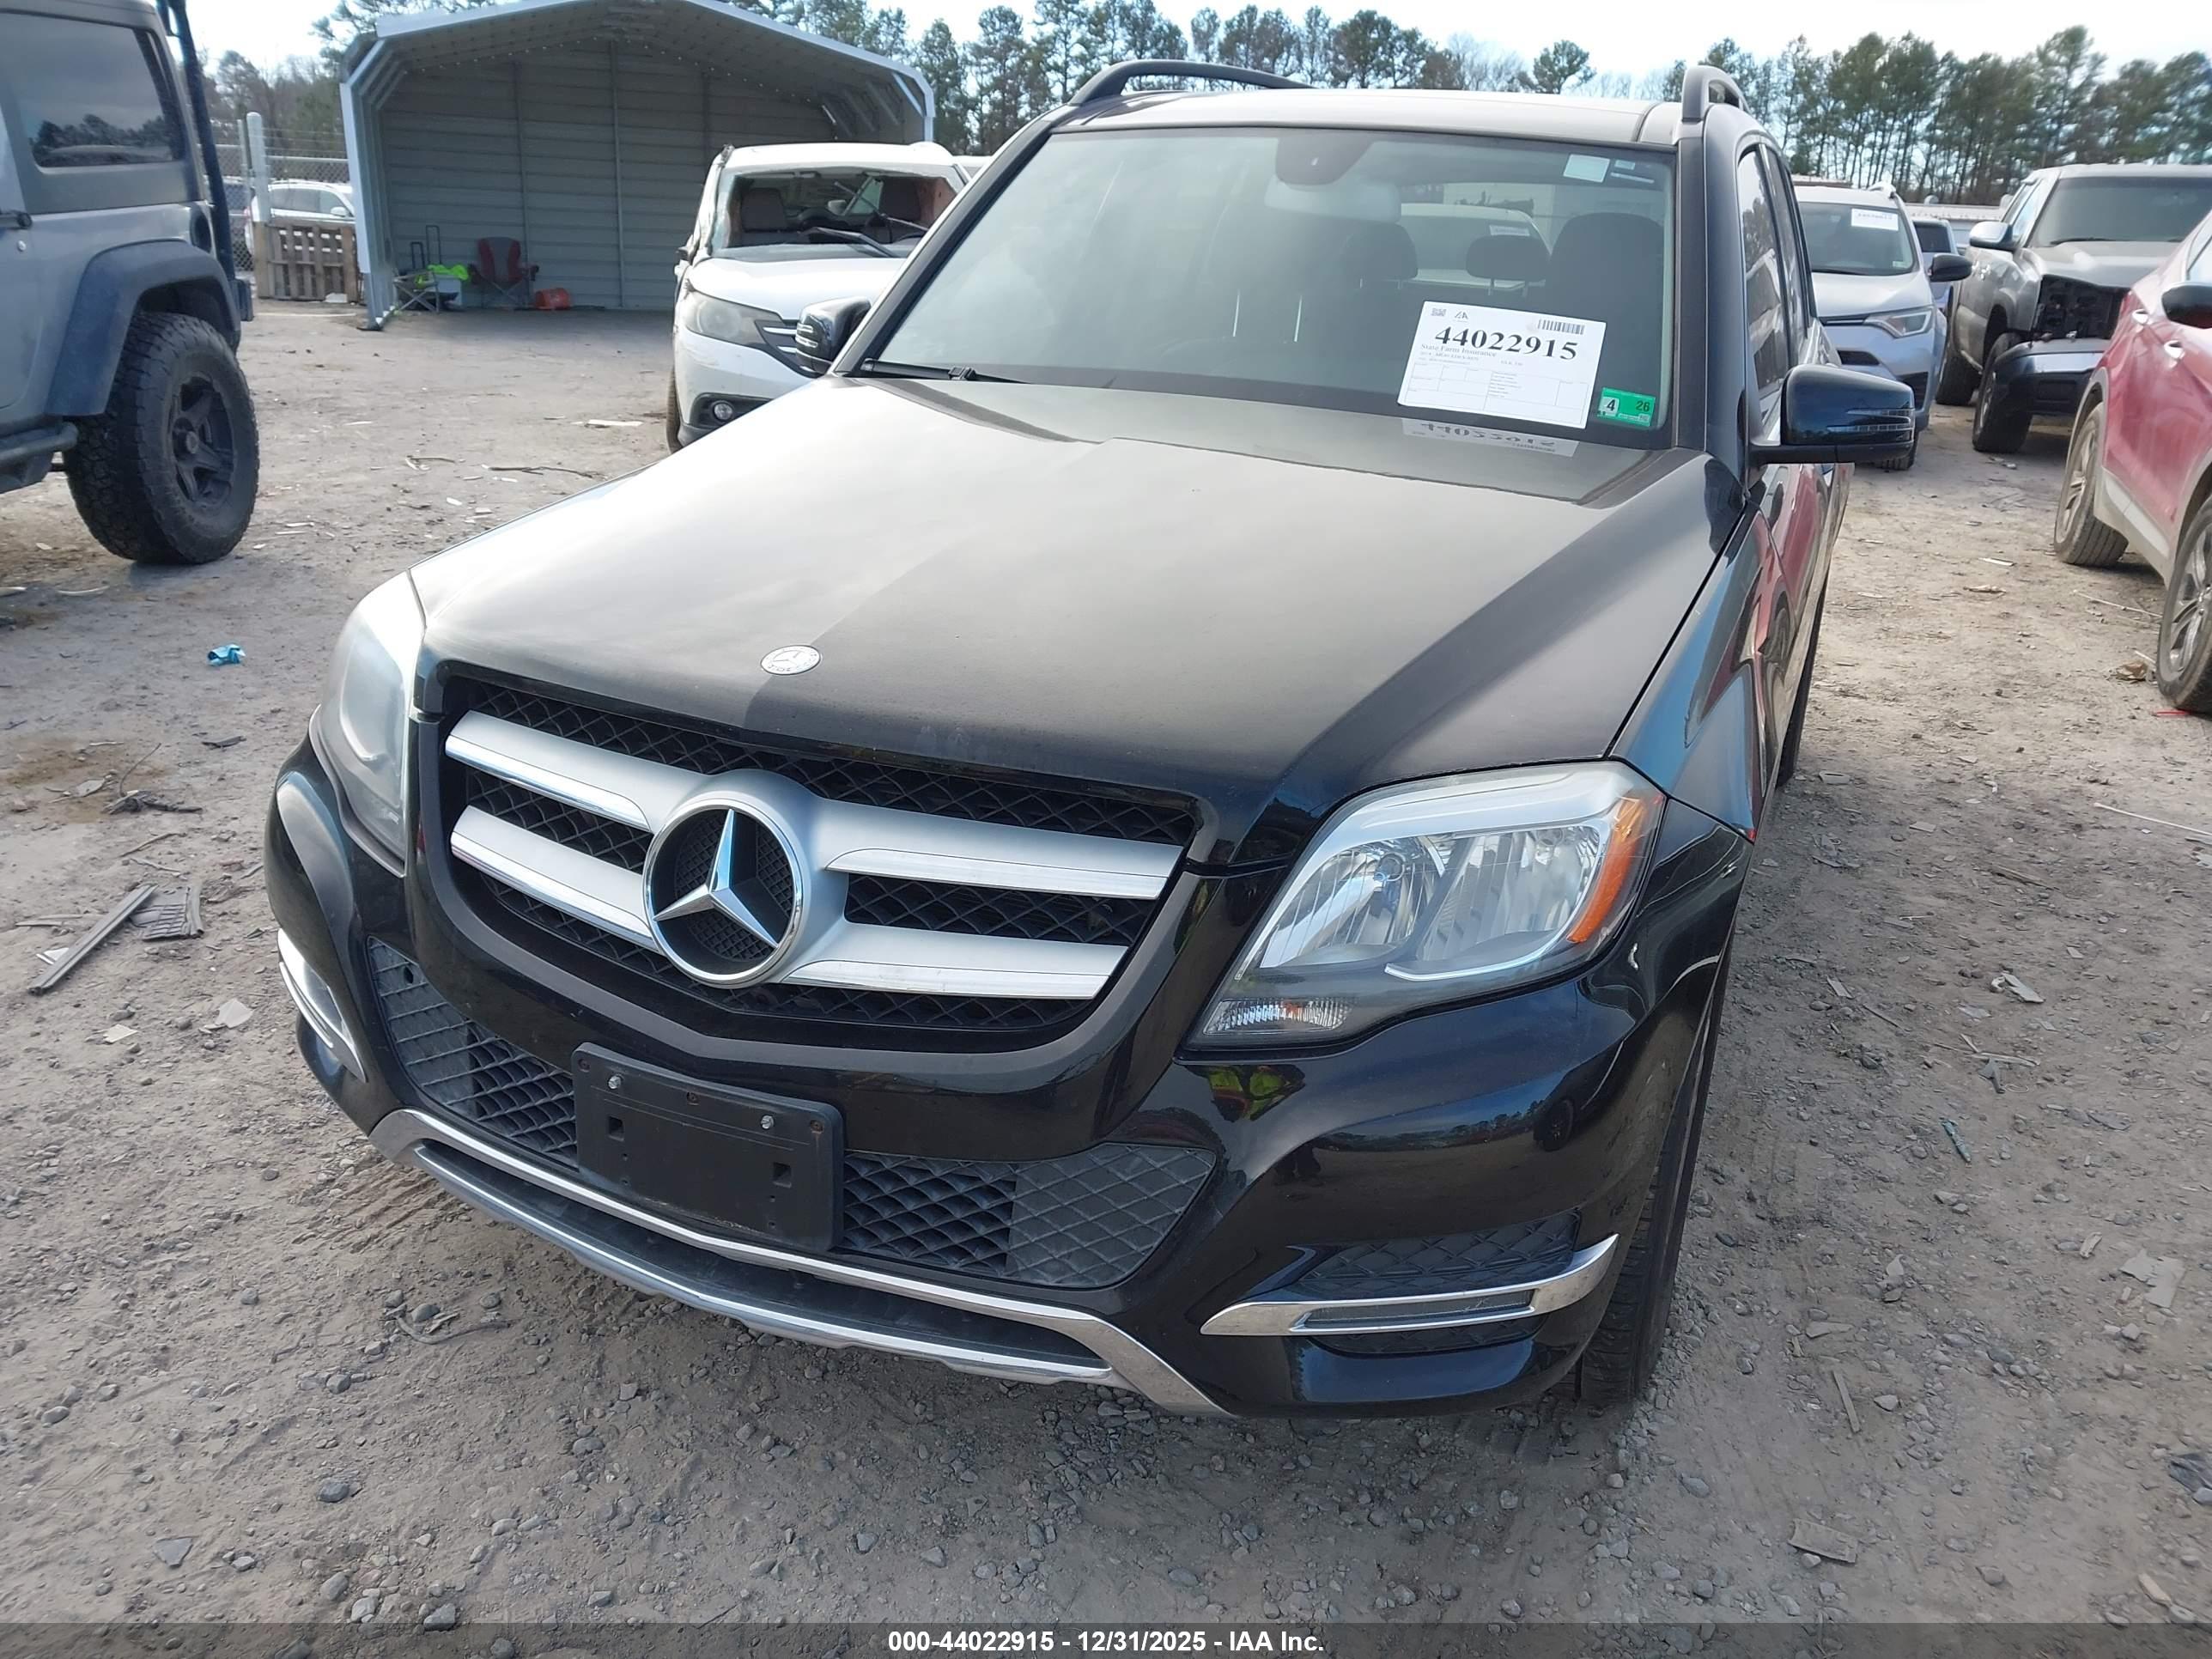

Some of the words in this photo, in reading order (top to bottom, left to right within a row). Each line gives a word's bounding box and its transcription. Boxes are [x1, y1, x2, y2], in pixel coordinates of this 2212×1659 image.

[1435, 326, 1578, 361] 44022915
[1607, 399, 1615, 410] 4
[1636, 400, 1650, 412] 26
